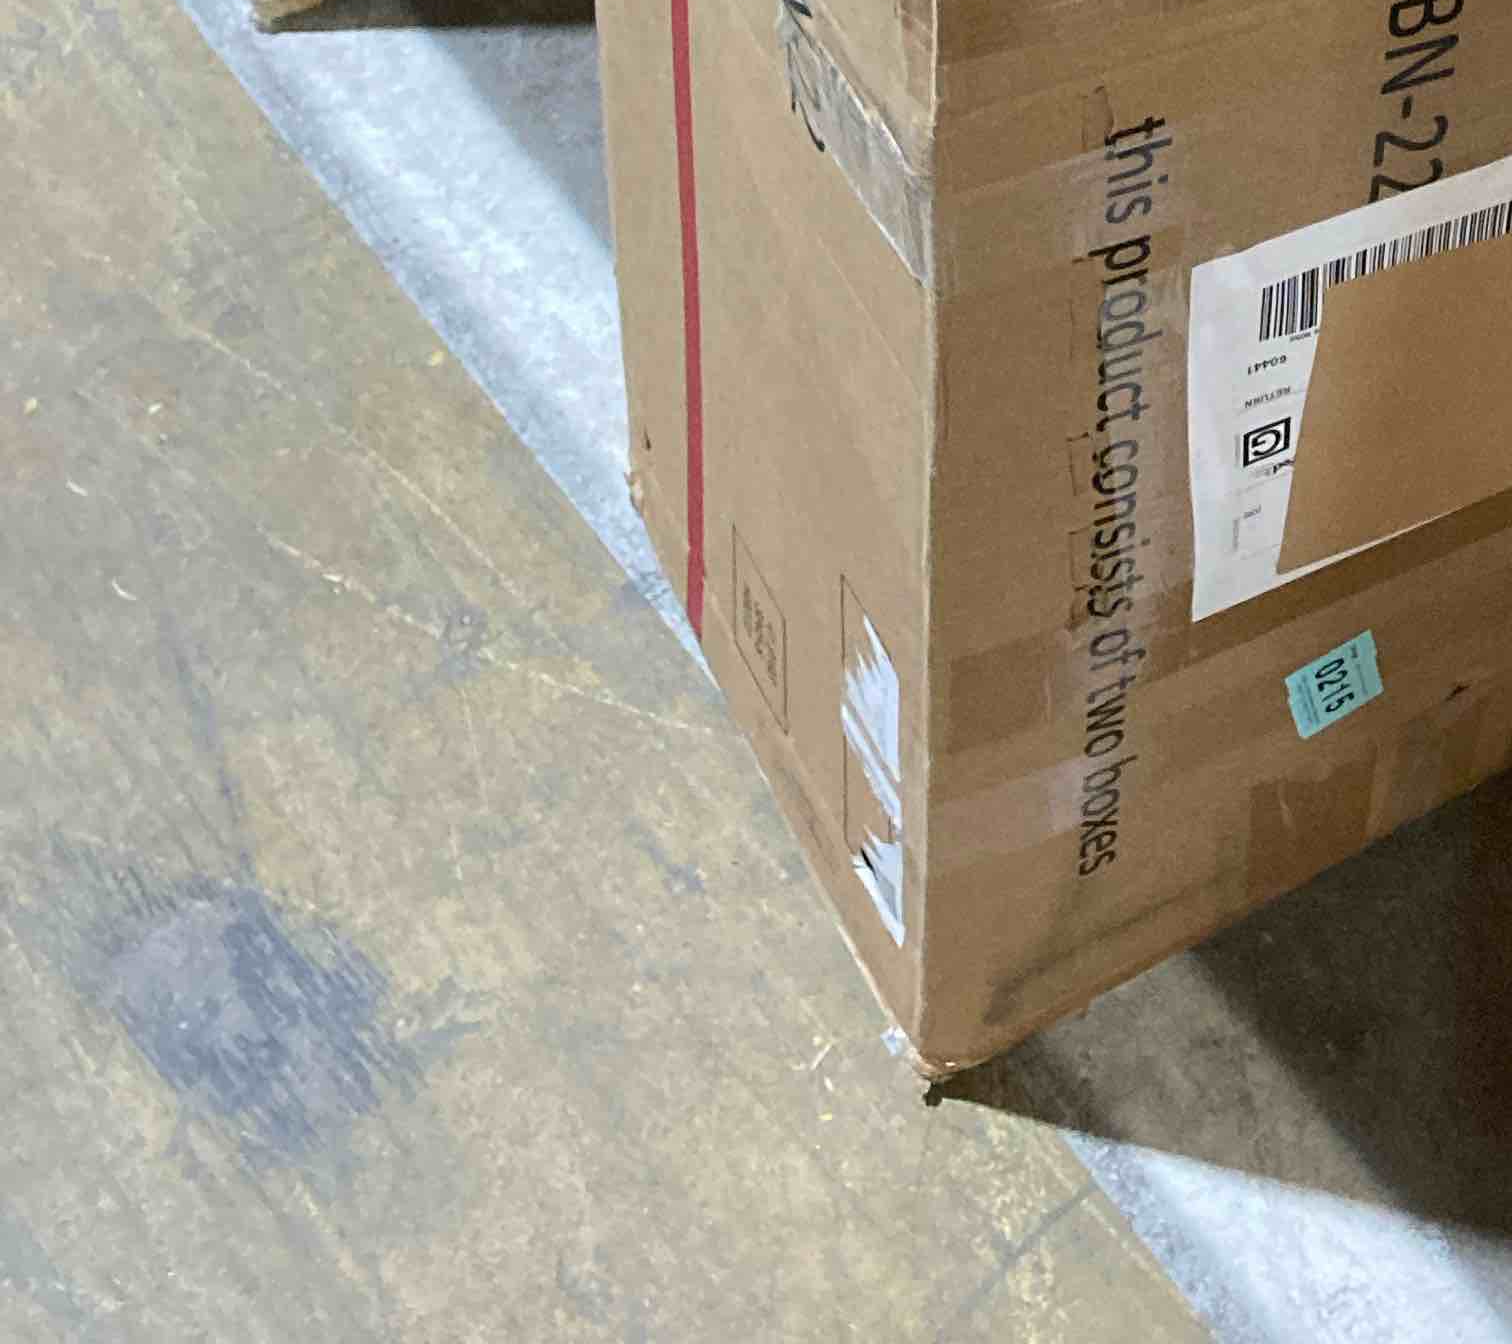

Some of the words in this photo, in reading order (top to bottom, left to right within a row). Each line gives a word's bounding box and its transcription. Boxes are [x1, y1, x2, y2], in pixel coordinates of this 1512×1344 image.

[1104, 116, 1173, 226] this
[1089, 235, 1163, 434] product
[1246, 353, 1288, 376] 60441
[1243, 384, 1292, 410] RETURN
[1251, 426, 1282, 457] G
[1086, 437, 1151, 623] consists
[1090, 624, 1147, 679] of
[1310, 655, 1351, 716] 0215
[1084, 677, 1138, 757] two
[1077, 755, 1139, 878] boxes
